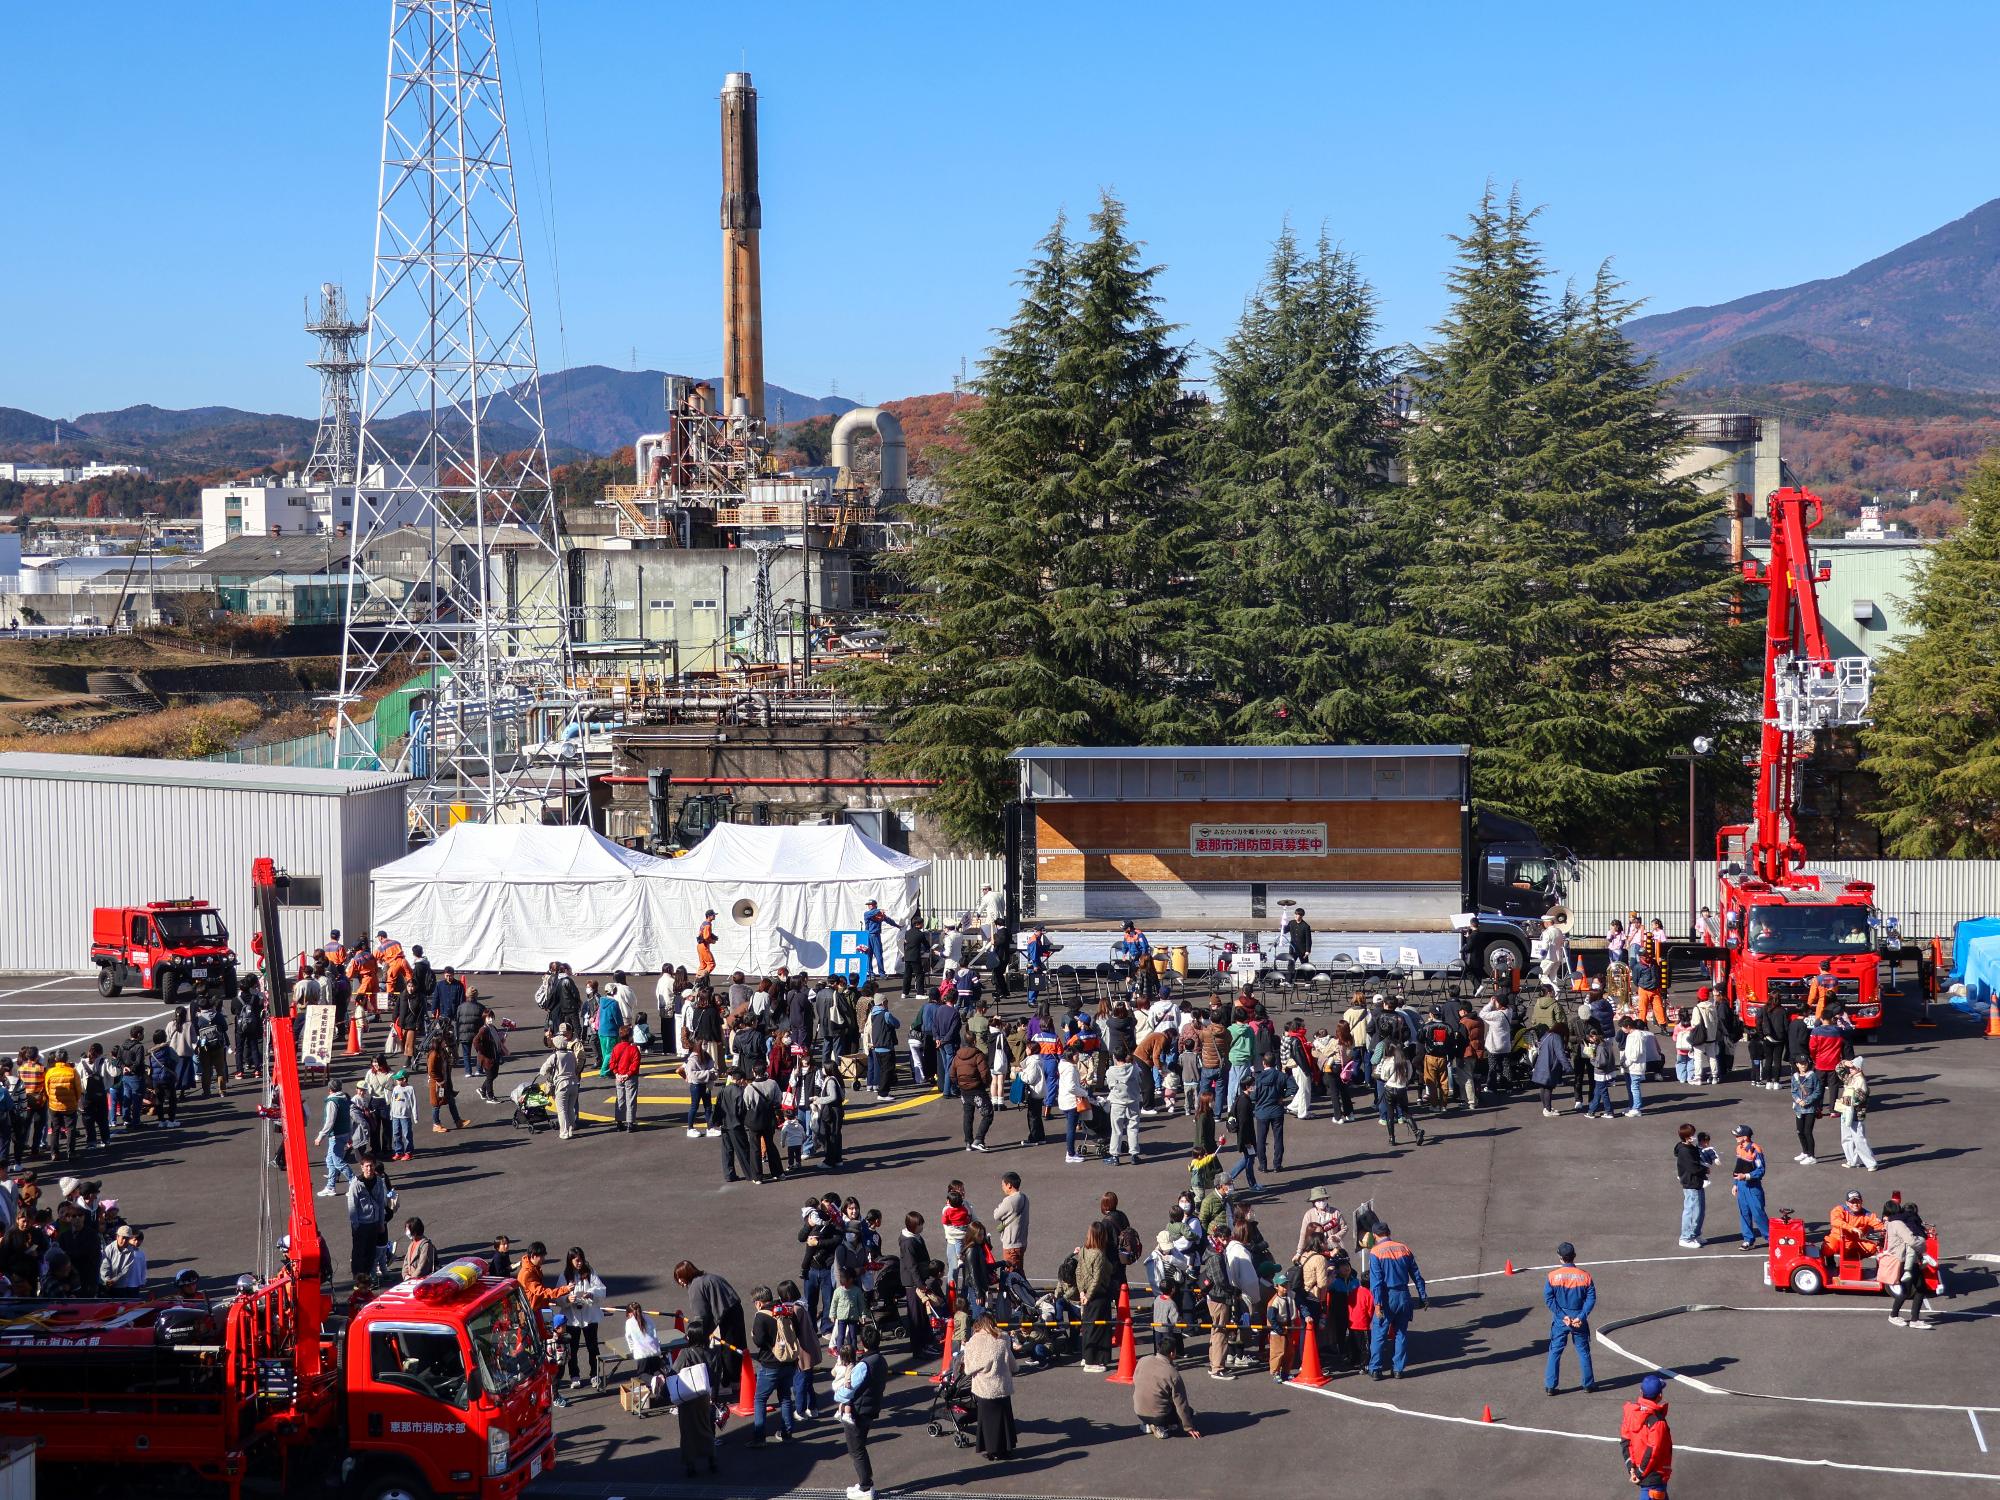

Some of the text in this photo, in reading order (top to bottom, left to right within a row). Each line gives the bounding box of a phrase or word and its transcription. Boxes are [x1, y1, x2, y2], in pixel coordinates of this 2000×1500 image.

[1196, 838, 1322, 852] 恵那市消防団員募集中
[390, 1421, 467, 1434] 恵那市消防本部
